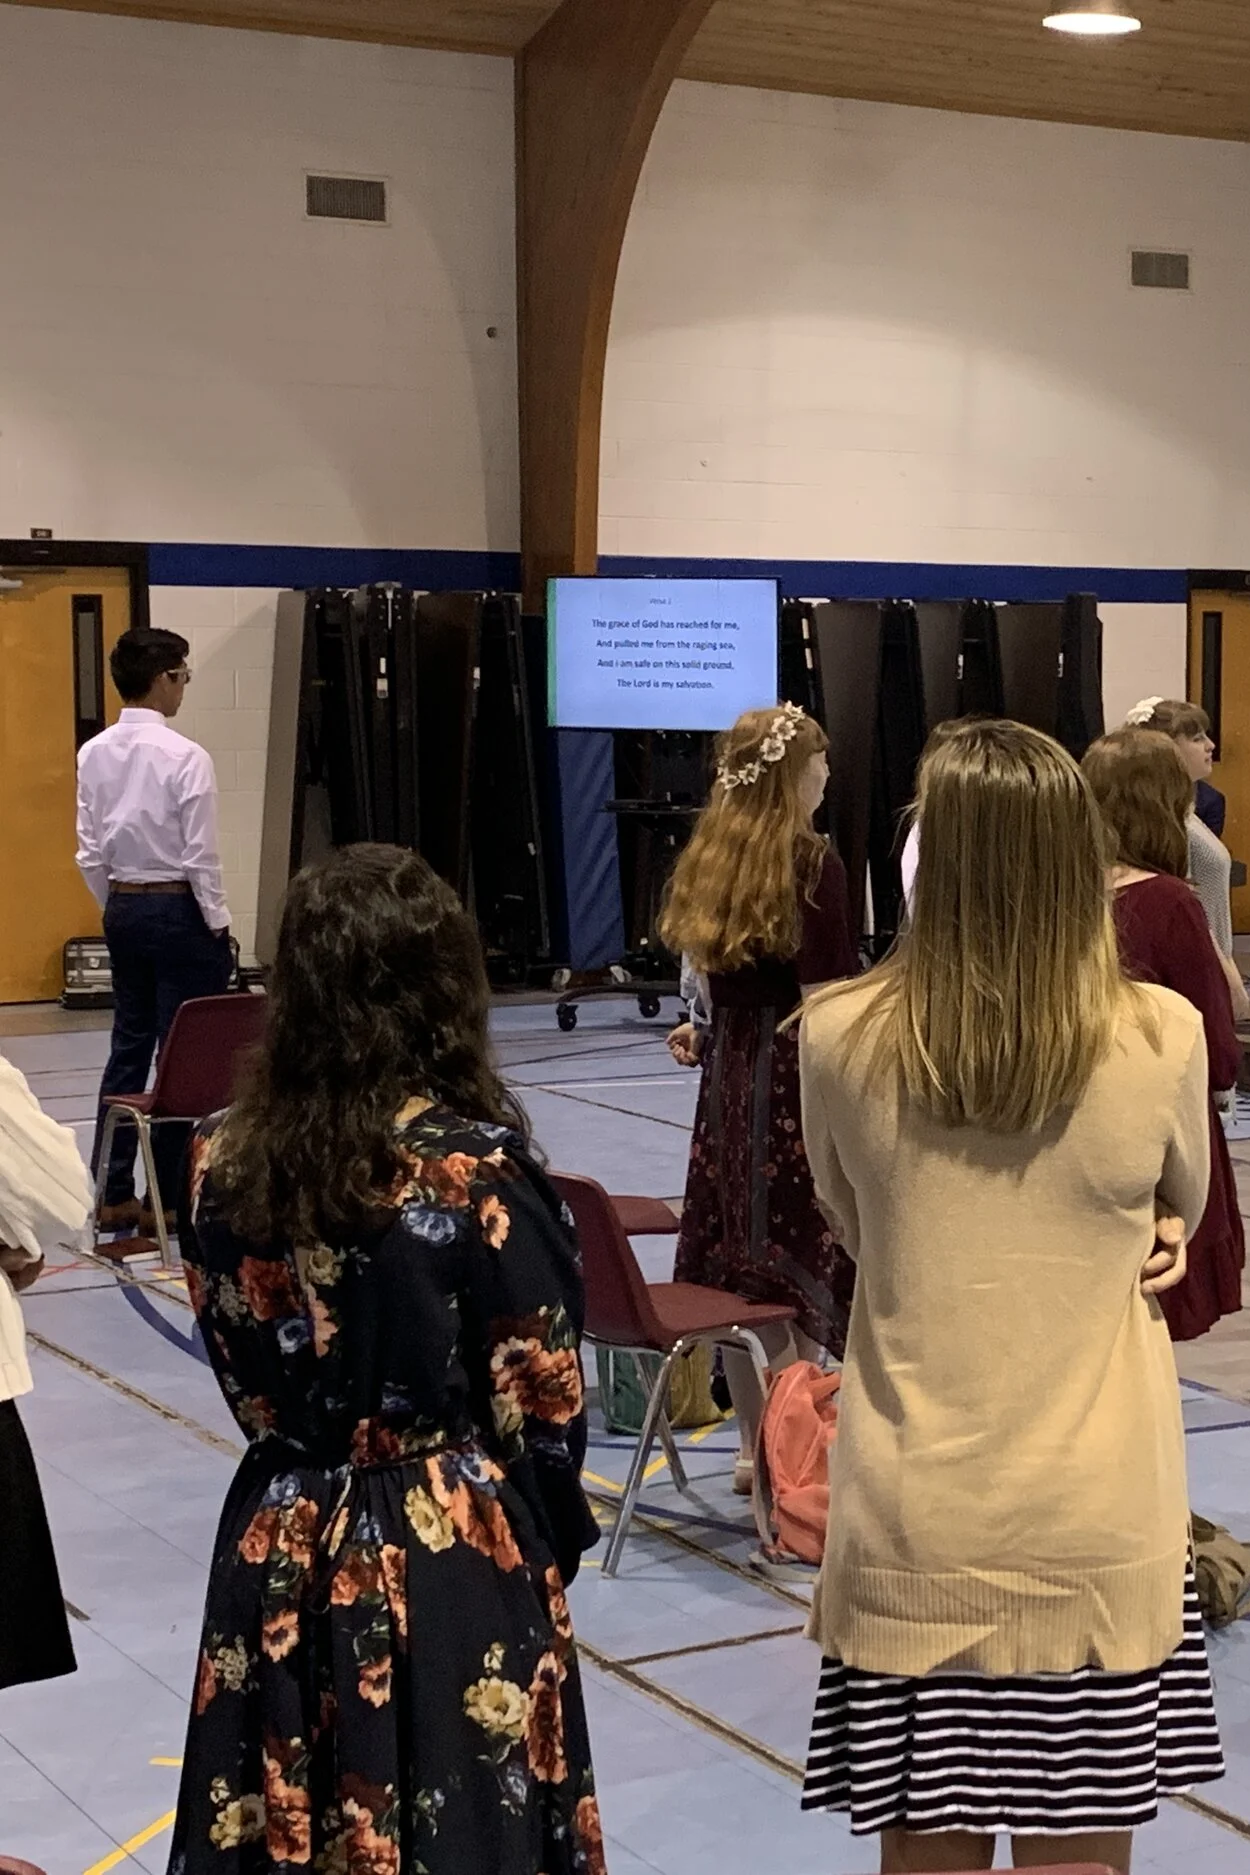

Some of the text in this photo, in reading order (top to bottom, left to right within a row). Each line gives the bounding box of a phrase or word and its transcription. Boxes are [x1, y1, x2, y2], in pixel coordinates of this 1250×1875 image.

[592, 618, 607, 628] The
[608, 621, 630, 630] grace
[631, 619, 641, 628] of
[641, 619, 659, 629] God
[660, 620, 675, 629] has
[676, 620, 709, 629] reached
[710, 619, 722, 629] for
[596, 639, 612, 648] And
[655, 639, 676, 649] from
[677, 640, 691, 649] the
[692, 641, 717, 651] raging
[597, 659, 614, 668] And
[634, 659, 651, 668] safe
[652, 661, 664, 669] on
[664, 660, 680, 669] this
[681, 660, 702, 670] solid
[617, 678, 632, 688] The
[633, 678, 652, 688] Lord
[653, 678, 660, 688] is
[661, 681, 674, 690] my
